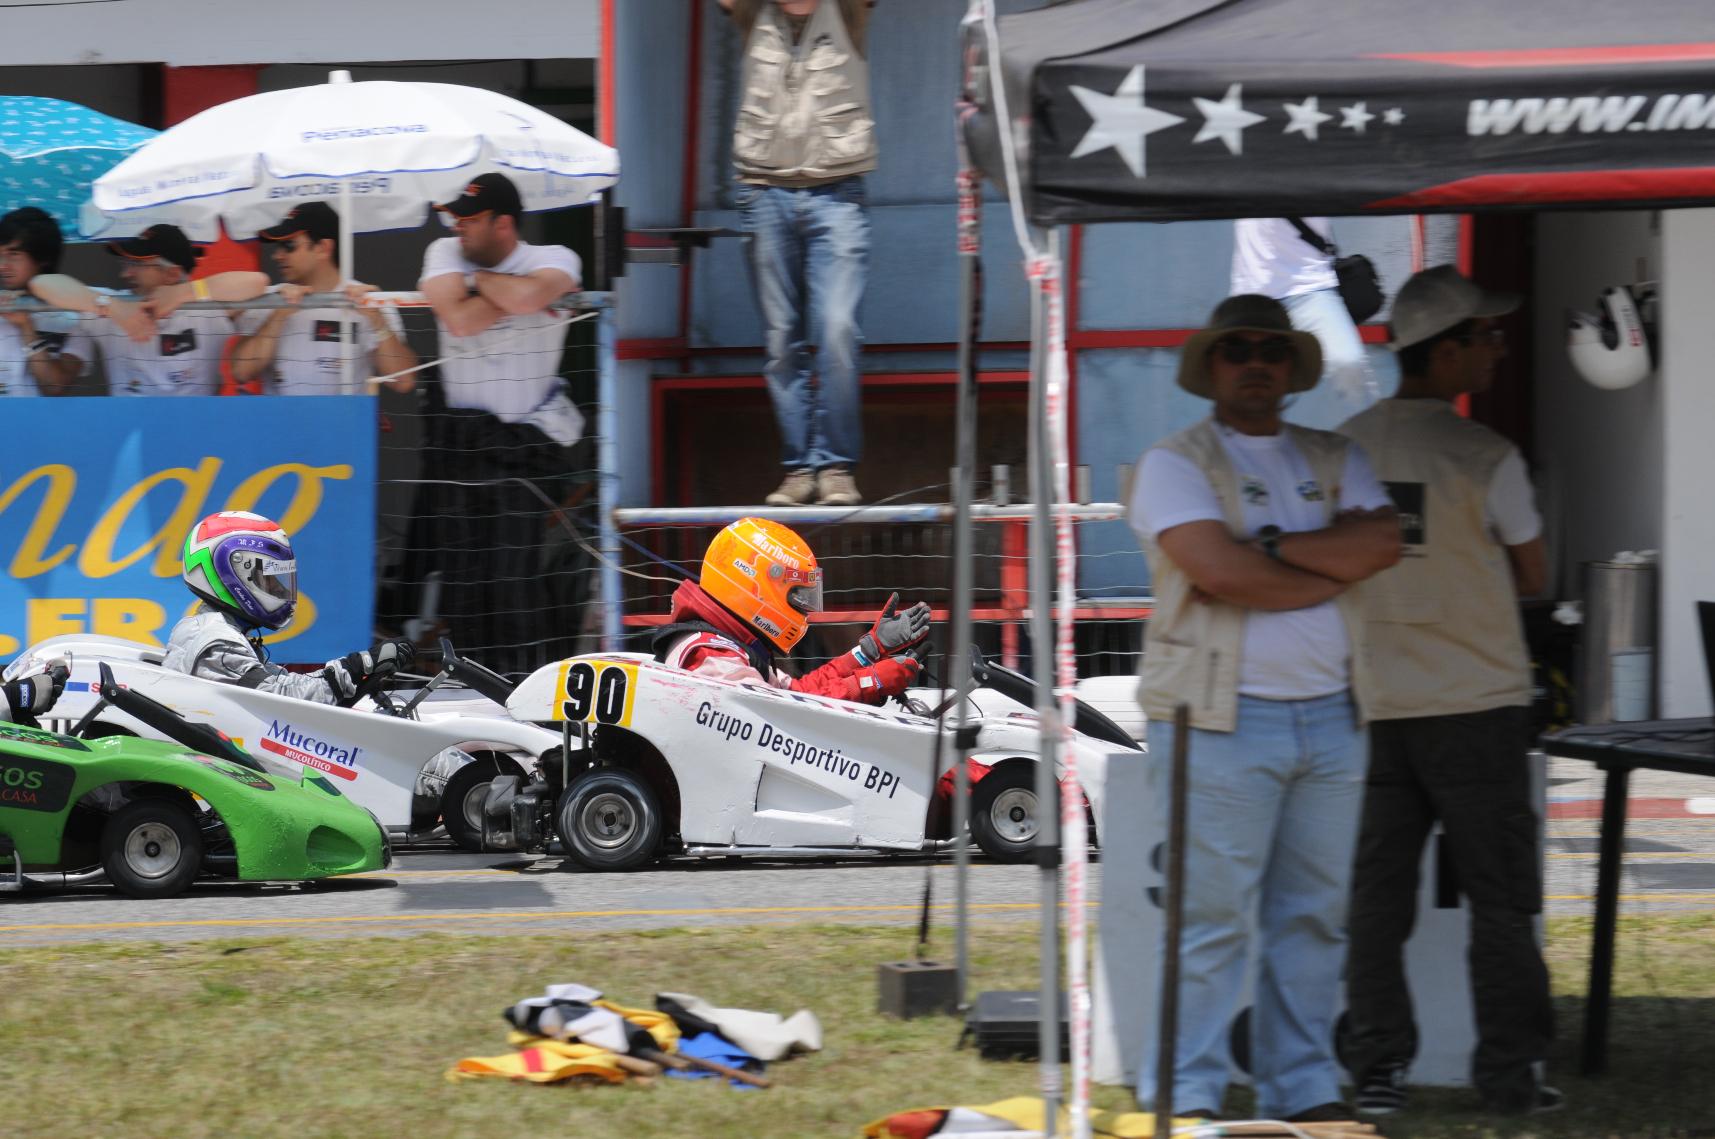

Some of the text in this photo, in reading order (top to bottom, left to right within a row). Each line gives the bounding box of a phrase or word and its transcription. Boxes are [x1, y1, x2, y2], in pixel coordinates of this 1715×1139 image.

[752, 532, 799, 570] Marlboro
[753, 615, 780, 638] Marlboro
[563, 662, 628, 725] 90
[267, 719, 359, 767] Mucoral
[696, 701, 901, 799] Grupo Desportivo BPI
[0, 766, 44, 790] OS
[2, 789, 38, 804] CASA
